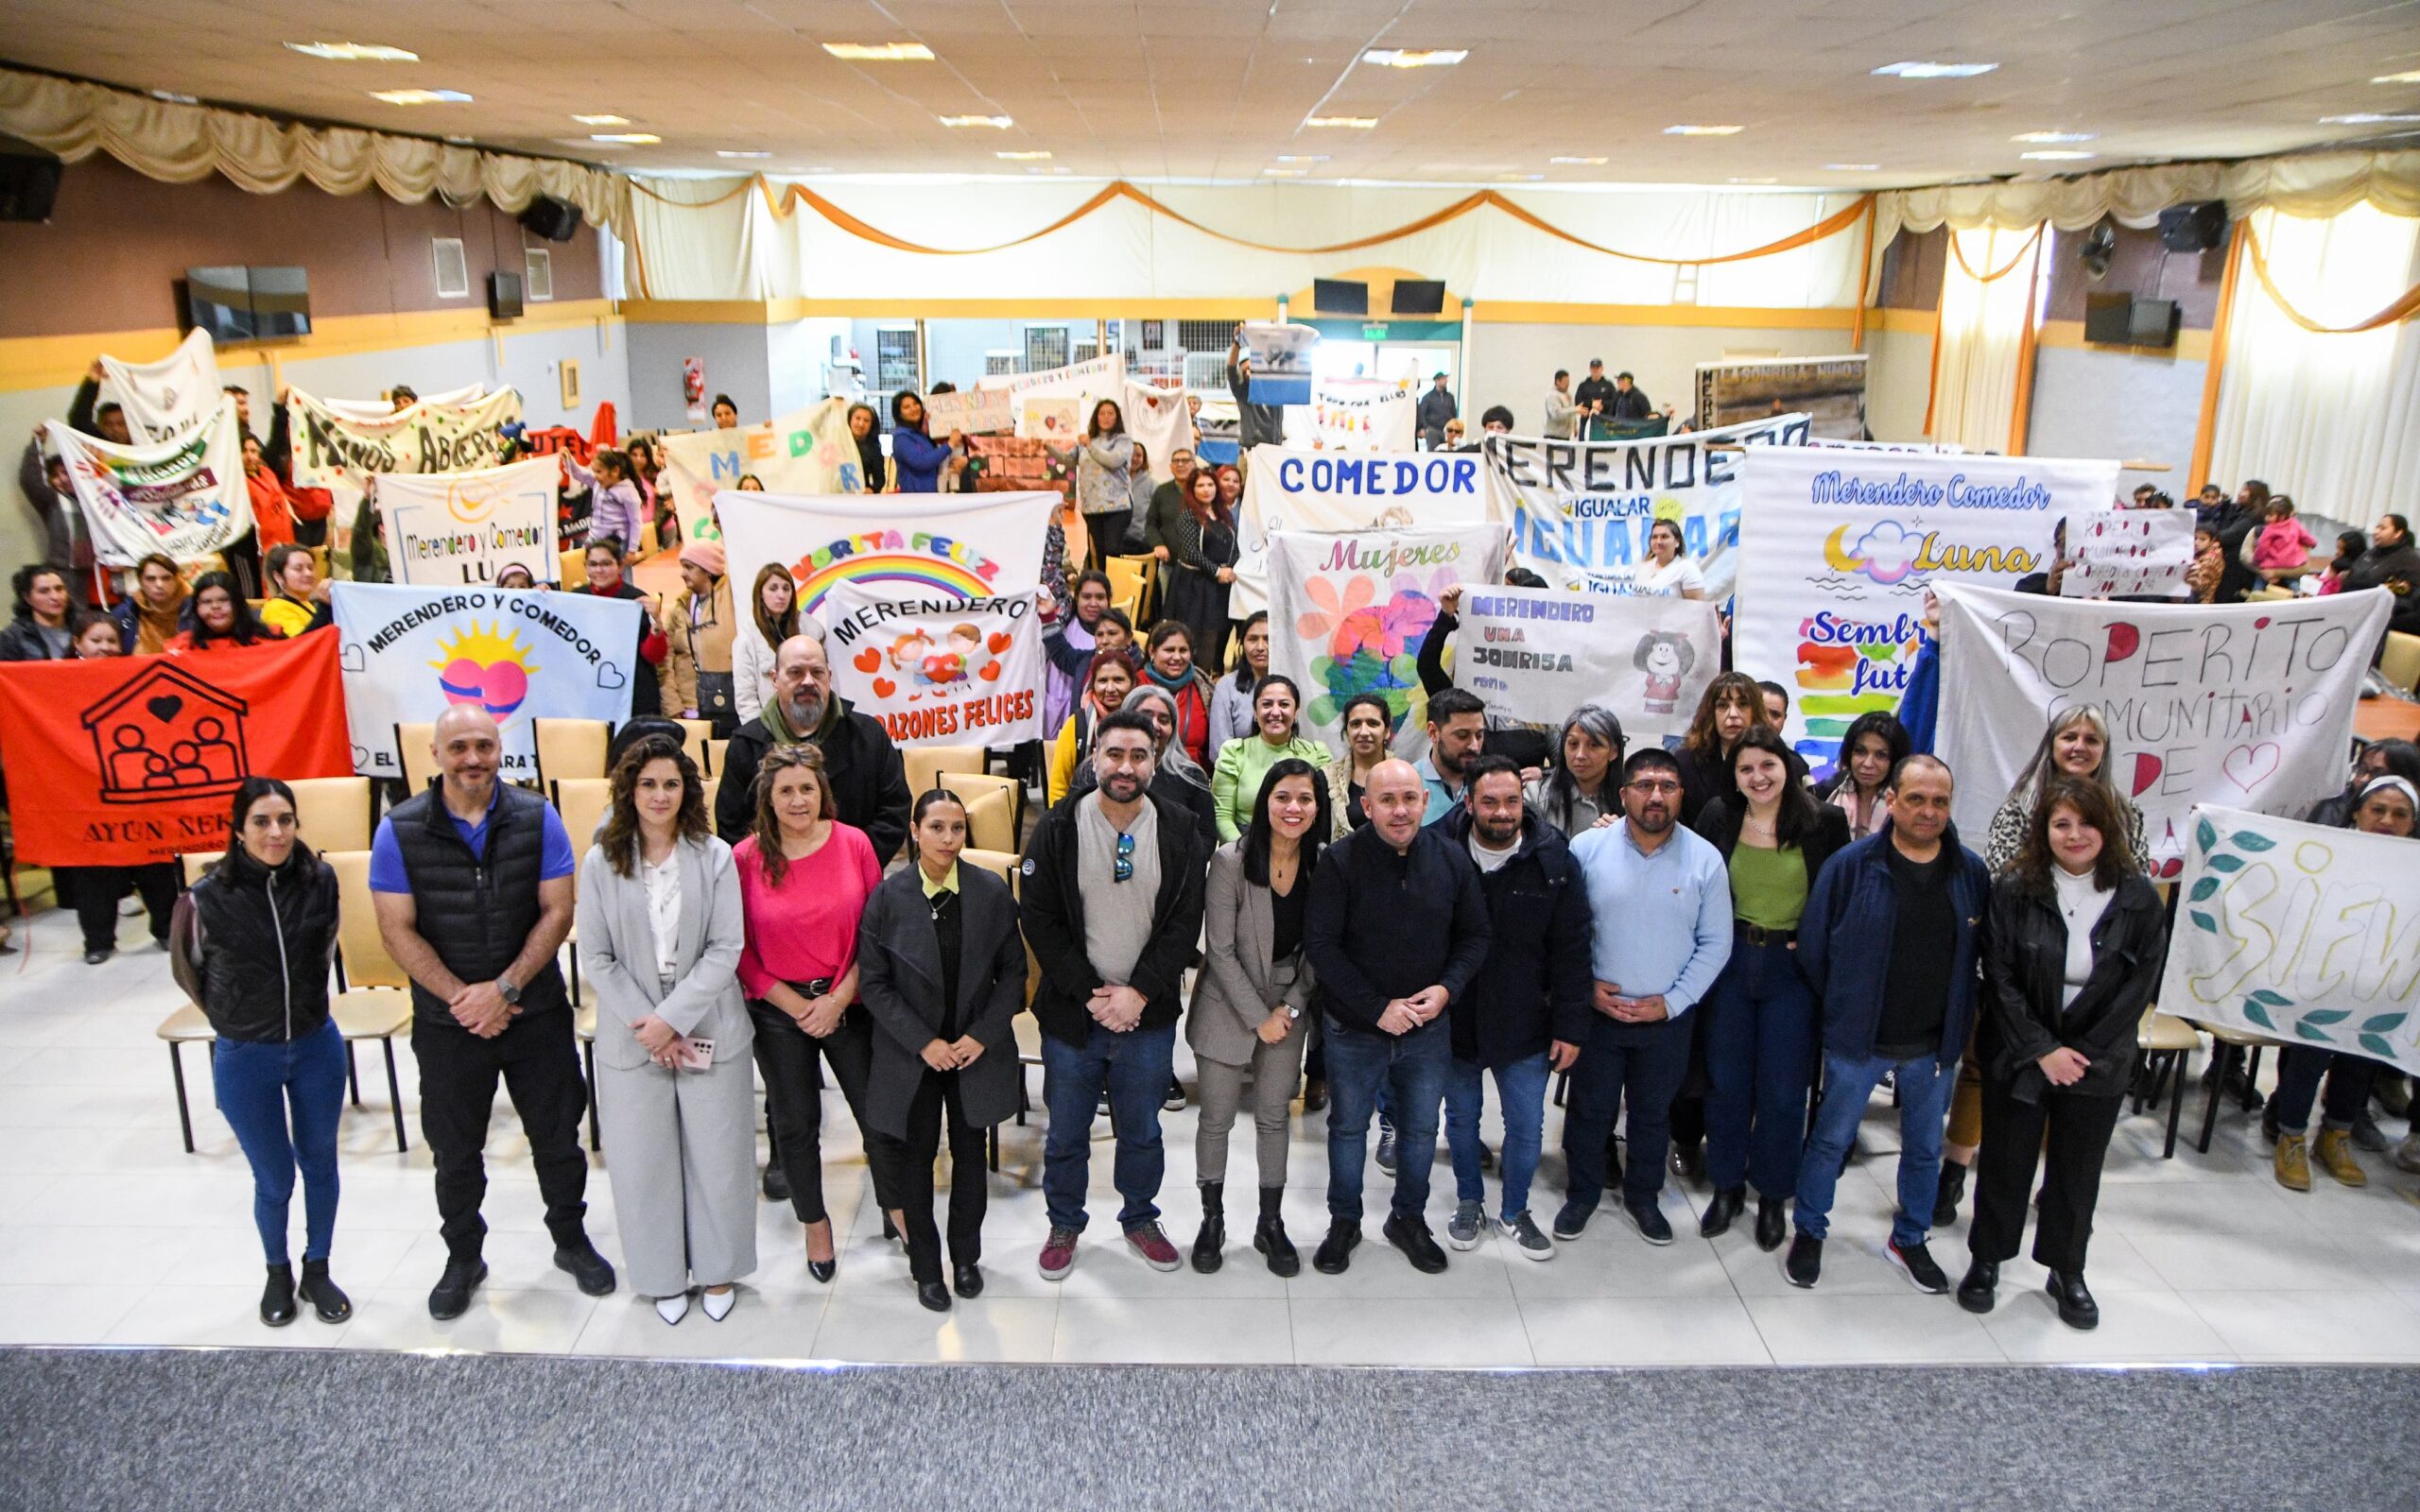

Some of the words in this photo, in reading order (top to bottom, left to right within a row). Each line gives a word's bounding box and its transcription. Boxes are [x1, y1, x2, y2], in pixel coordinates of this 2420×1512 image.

[1280, 457, 1477, 495] COMEDOR
[1812, 470, 1944, 507] Merendero
[1946, 473, 2051, 511] Comedor
[1574, 496, 1651, 518] IGUALAR
[490, 521, 544, 550] Comedor
[1911, 530, 2042, 573] Luna
[911, 531, 1000, 582] FELIZ
[1319, 539, 1461, 578] Mujeres
[833, 597, 1028, 646] MERENDERO
[1471, 596, 1595, 623] MERENDERO
[1809, 610, 1927, 644] Sembr
[367, 593, 486, 654] MERENDERO
[493, 593, 506, 610] Y
[510, 596, 602, 665] COMEDOR
[1484, 626, 1526, 643] UNA
[1851, 658, 1910, 696] fut
[963, 689, 1034, 730] FELICES
[374, 752, 394, 766] EL
[499, 754, 527, 768] ARA
[2122, 746, 2199, 798] DE
